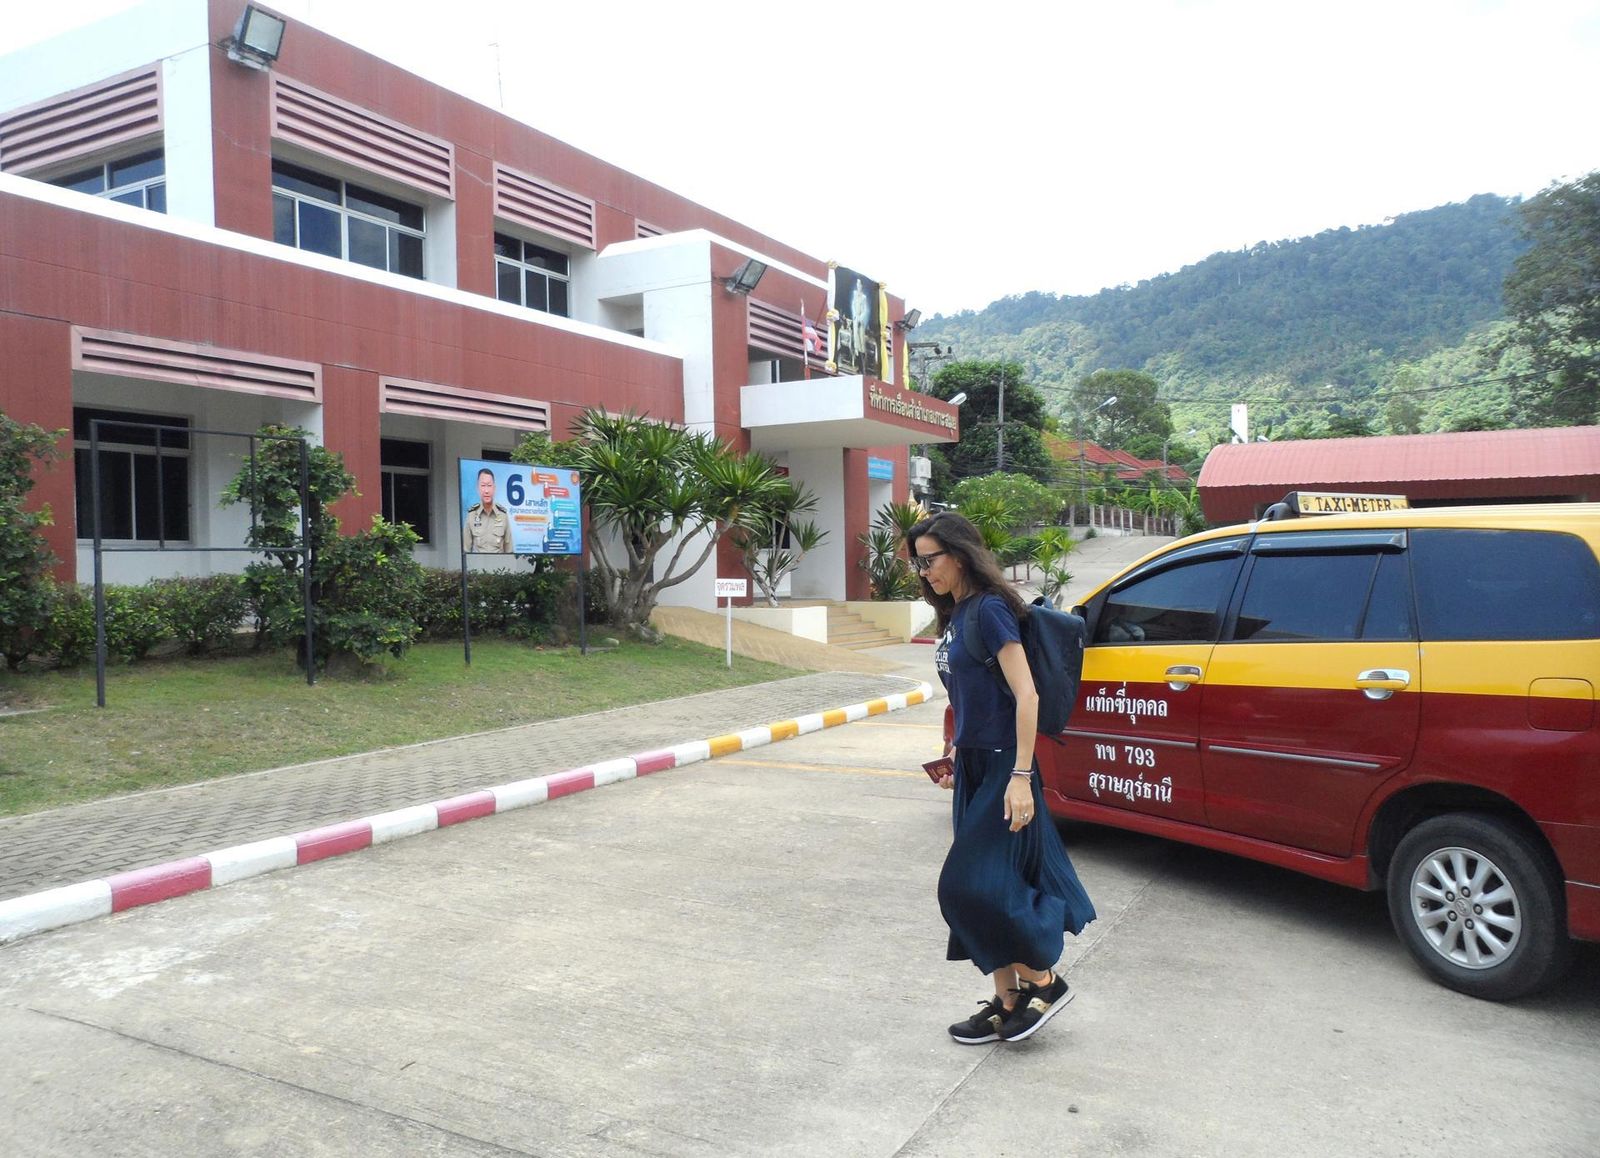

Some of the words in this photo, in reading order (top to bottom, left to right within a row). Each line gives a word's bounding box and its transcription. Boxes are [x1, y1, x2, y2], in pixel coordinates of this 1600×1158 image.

[506, 473, 525, 506] 6
[1315, 496, 1392, 513] TAXI-METER
[1086, 681, 1168, 724] แท็กซี่บุคคล
[1095, 743, 1116, 761] ทข
[1124, 745, 1156, 768] 793
[1089, 772, 1172, 802] สุราษฎร์ธานี
